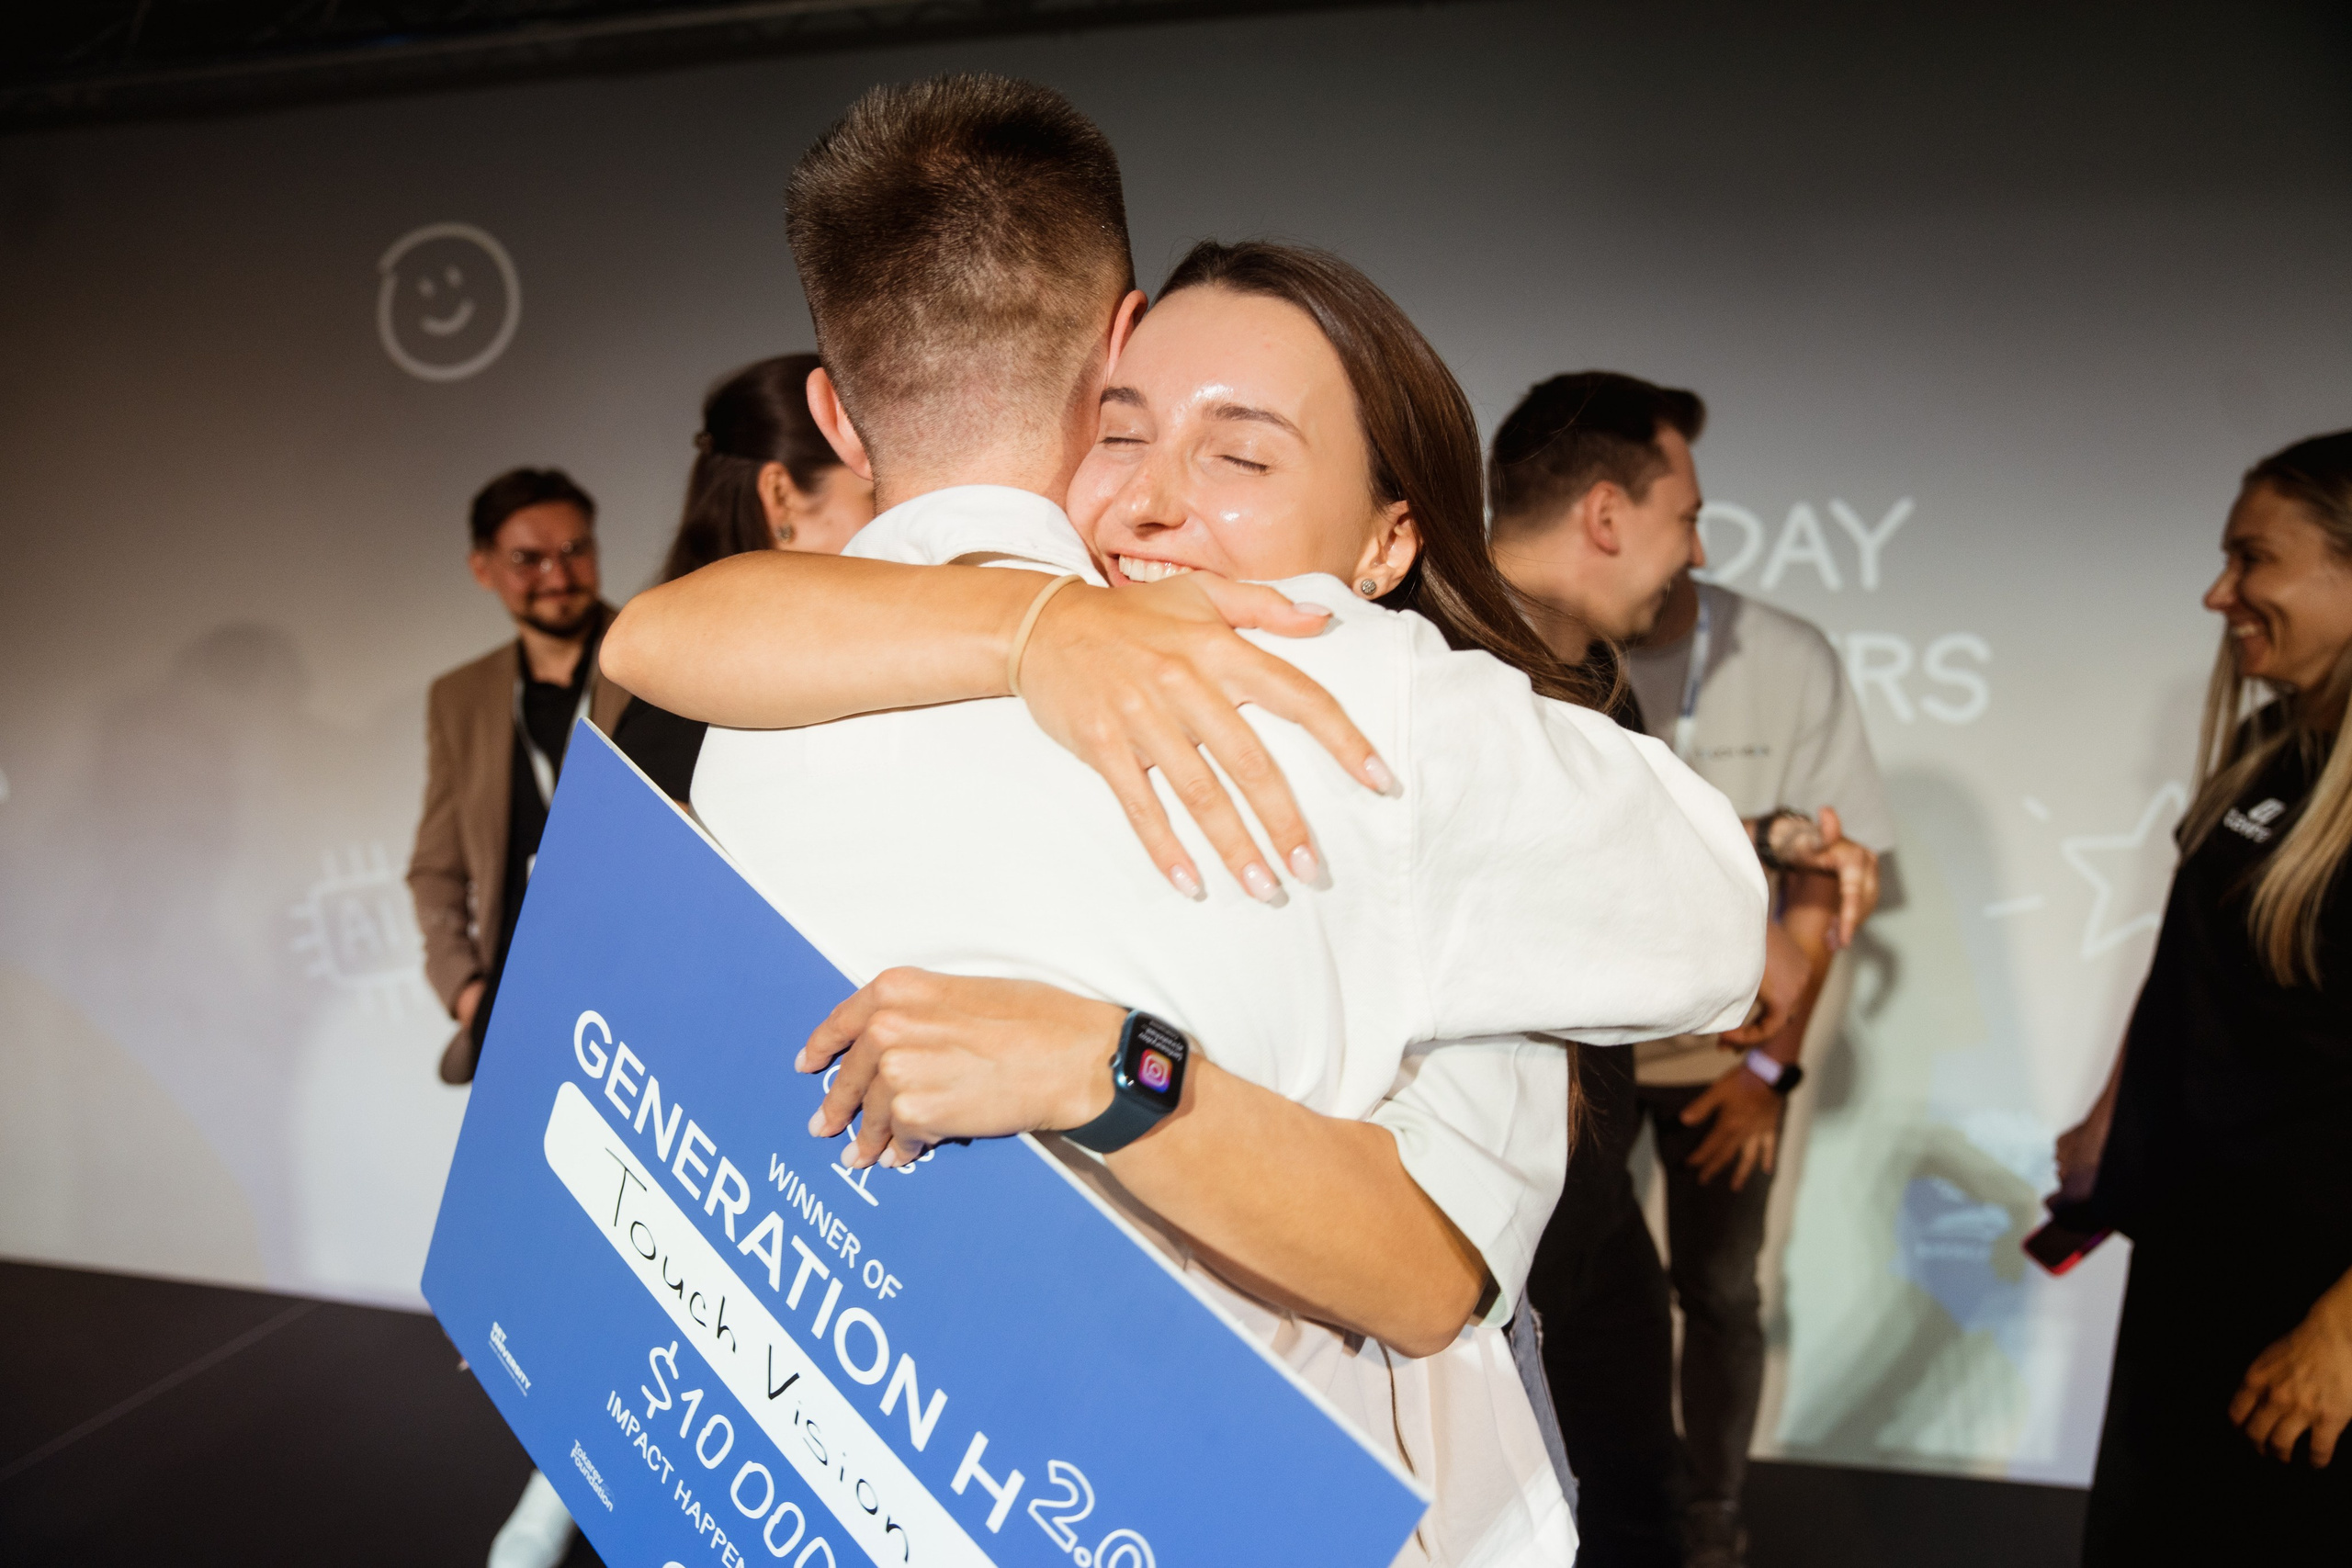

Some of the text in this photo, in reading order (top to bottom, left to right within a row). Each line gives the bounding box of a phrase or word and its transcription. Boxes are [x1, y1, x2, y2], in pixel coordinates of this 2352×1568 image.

[1689, 494, 1916, 592] DAY
[1830, 631, 1991, 725] RS
[573, 1010, 949, 1453] GENERATION
[768, 1152, 904, 1301] WINNER OF
[490, 1329, 532, 1390] UNIVERSITY
[605, 1146, 910, 1563] Touch Vision
[570, 1448, 614, 1513] Foundation
[573, 1438, 604, 1484] Tokarev
[605, 1390, 674, 1484] IMPACT
